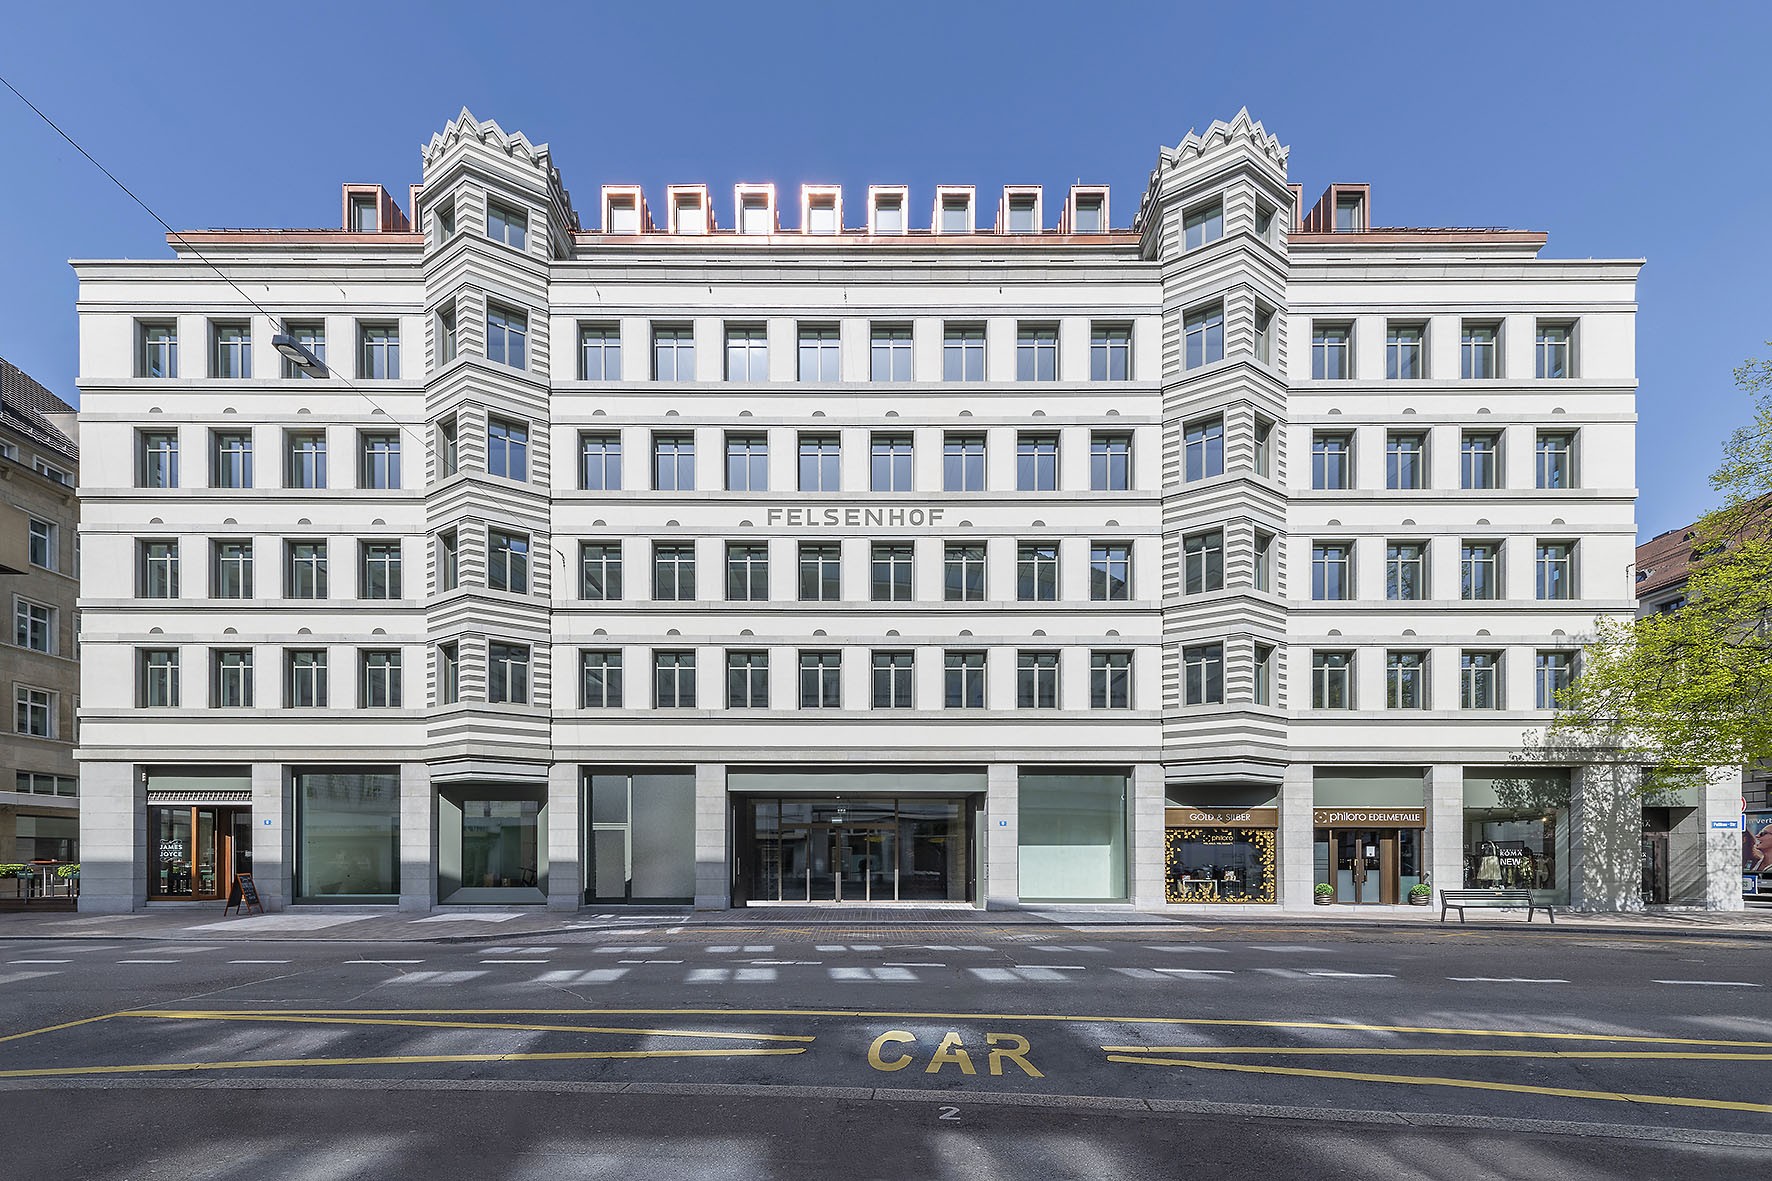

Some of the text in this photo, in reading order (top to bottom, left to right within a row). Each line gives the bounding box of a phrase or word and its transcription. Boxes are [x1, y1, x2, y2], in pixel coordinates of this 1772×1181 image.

[767, 508, 945, 526] FELSENHOF
[1189, 813, 1251, 821] GOLD & SILBER
[1329, 811, 1420, 823] philoro EDELMETALLE
[1499, 858, 1521, 866] NEW
[867, 1030, 1045, 1078] CAR
[939, 1106, 961, 1120] 2
